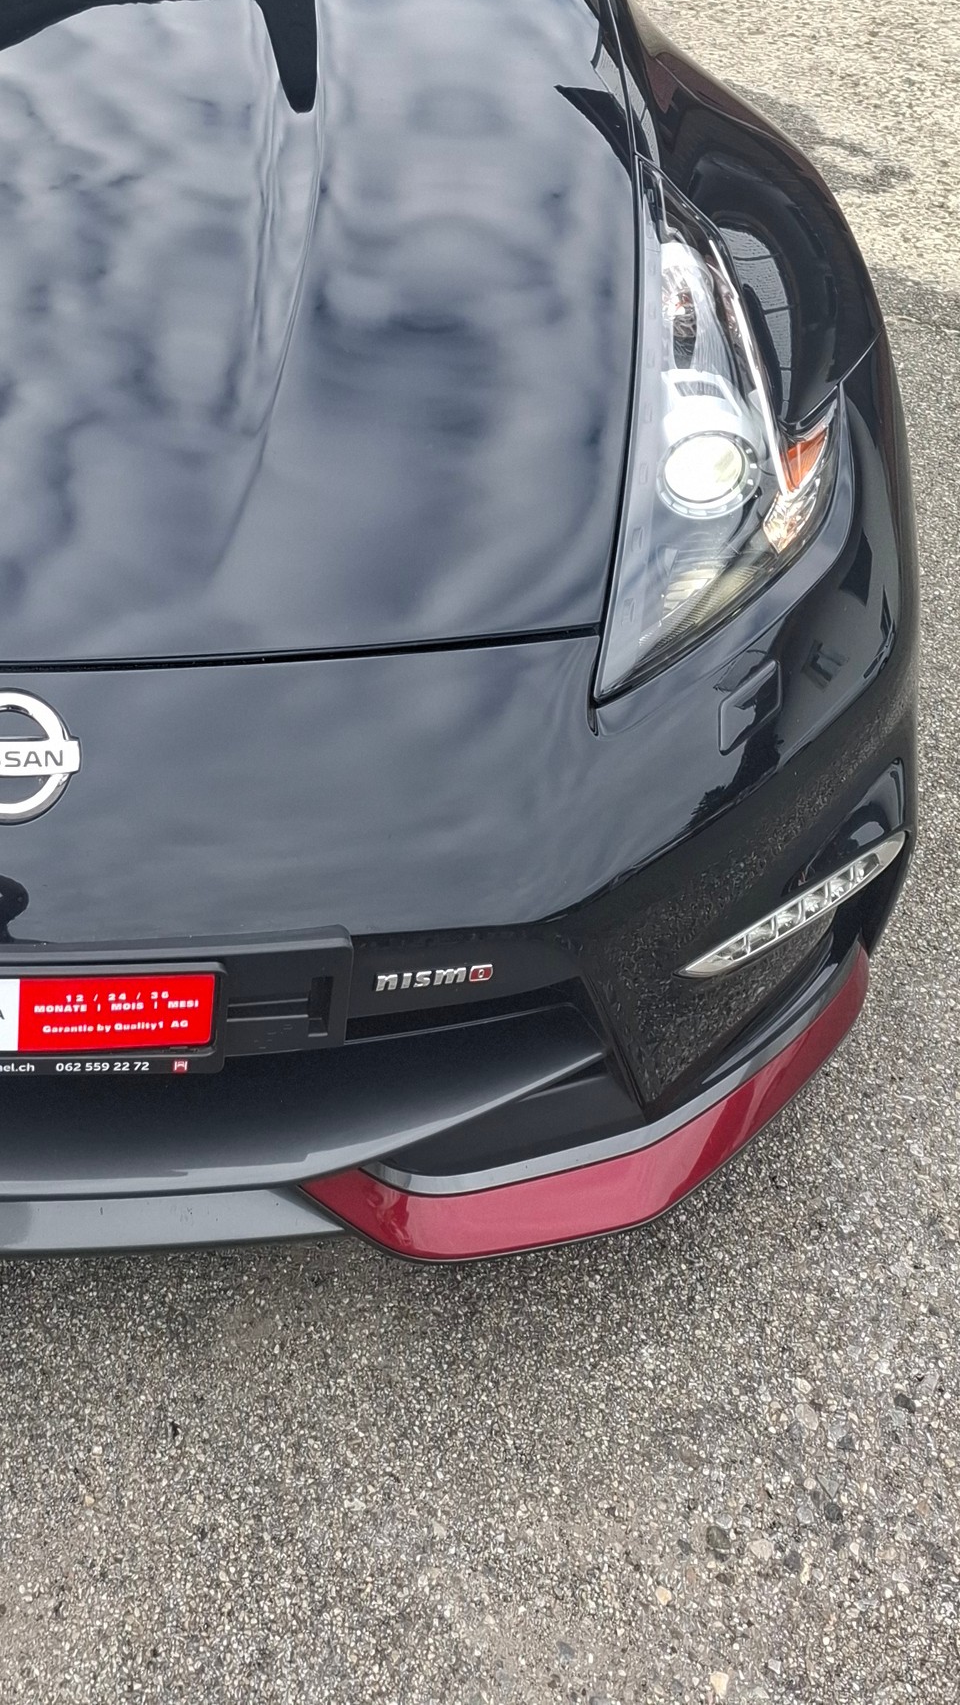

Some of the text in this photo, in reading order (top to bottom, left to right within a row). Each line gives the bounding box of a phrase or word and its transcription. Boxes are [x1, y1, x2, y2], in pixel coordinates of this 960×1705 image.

[65, 994, 84, 1002] 12
[108, 993, 127, 1001] 24
[34, 1004, 87, 1013] MONATE
[111, 1002, 144, 1011] MOIS
[167, 999, 199, 1009] MESI
[42, 1020, 189, 1033] Garantie by Quality1 AG
[55, 1062, 82, 1072] 062
[84, 1061, 110, 1072] 559
[113, 1061, 130, 1071] 22
[133, 1061, 150, 1071] 72
